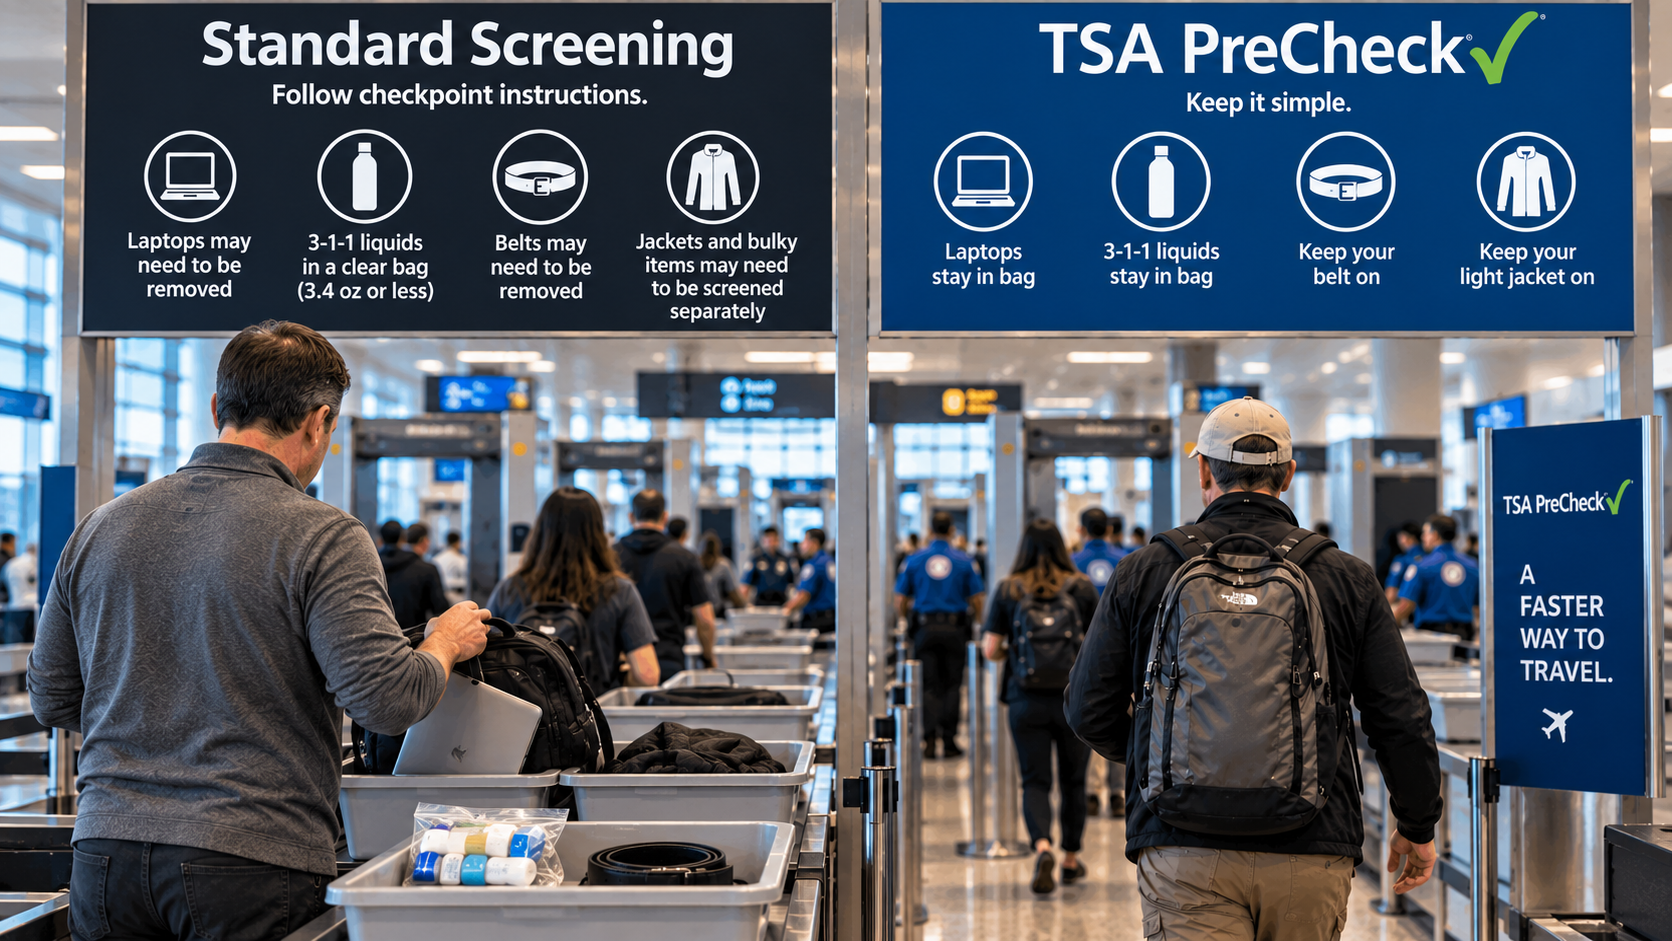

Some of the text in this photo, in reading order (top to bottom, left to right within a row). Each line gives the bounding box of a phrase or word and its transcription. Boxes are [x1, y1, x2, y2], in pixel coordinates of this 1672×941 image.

[202, 18, 733, 79] Standard Screening
[1038, 20, 1466, 75] TSA PreCheck
[272, 82, 648, 111] Follow checkpoint instructions.
[1186, 90, 1352, 118] Keep it simple.
[128, 231, 252, 254] Laptops may
[308, 232, 424, 256] 3-1-1 liquids
[495, 233, 588, 256] Belts may
[635, 231, 798, 254] Jackets and bulky
[945, 242, 1023, 265] Laptops
[1103, 241, 1220, 264] 3-1-1 liquids
[1299, 242, 1396, 265] Keep your
[1480, 242, 1577, 265] Keep your
[138, 255, 242, 274] need to be
[302, 257, 429, 280] in a clear bag
[491, 257, 592, 276] need to be
[645, 255, 789, 278] items may need
[1313, 266, 1381, 285] belt on
[146, 279, 232, 298] removed
[651, 278, 784, 297] to be screened
[932, 266, 1036, 290] stay in bag
[1110, 266, 1213, 290] stay in bag
[1460, 266, 1595, 290] light jacket on
[297, 280, 434, 303] (3.4 oz or less)
[499, 281, 583, 300] removed
[669, 301, 767, 324] separately
[1502, 490, 1605, 515] TSA PreCheck
[1519, 563, 1536, 585] A
[1520, 594, 1605, 617] FASTER
[1519, 627, 1605, 650] WAY TO
[1519, 659, 1614, 683] TRAVEL.
